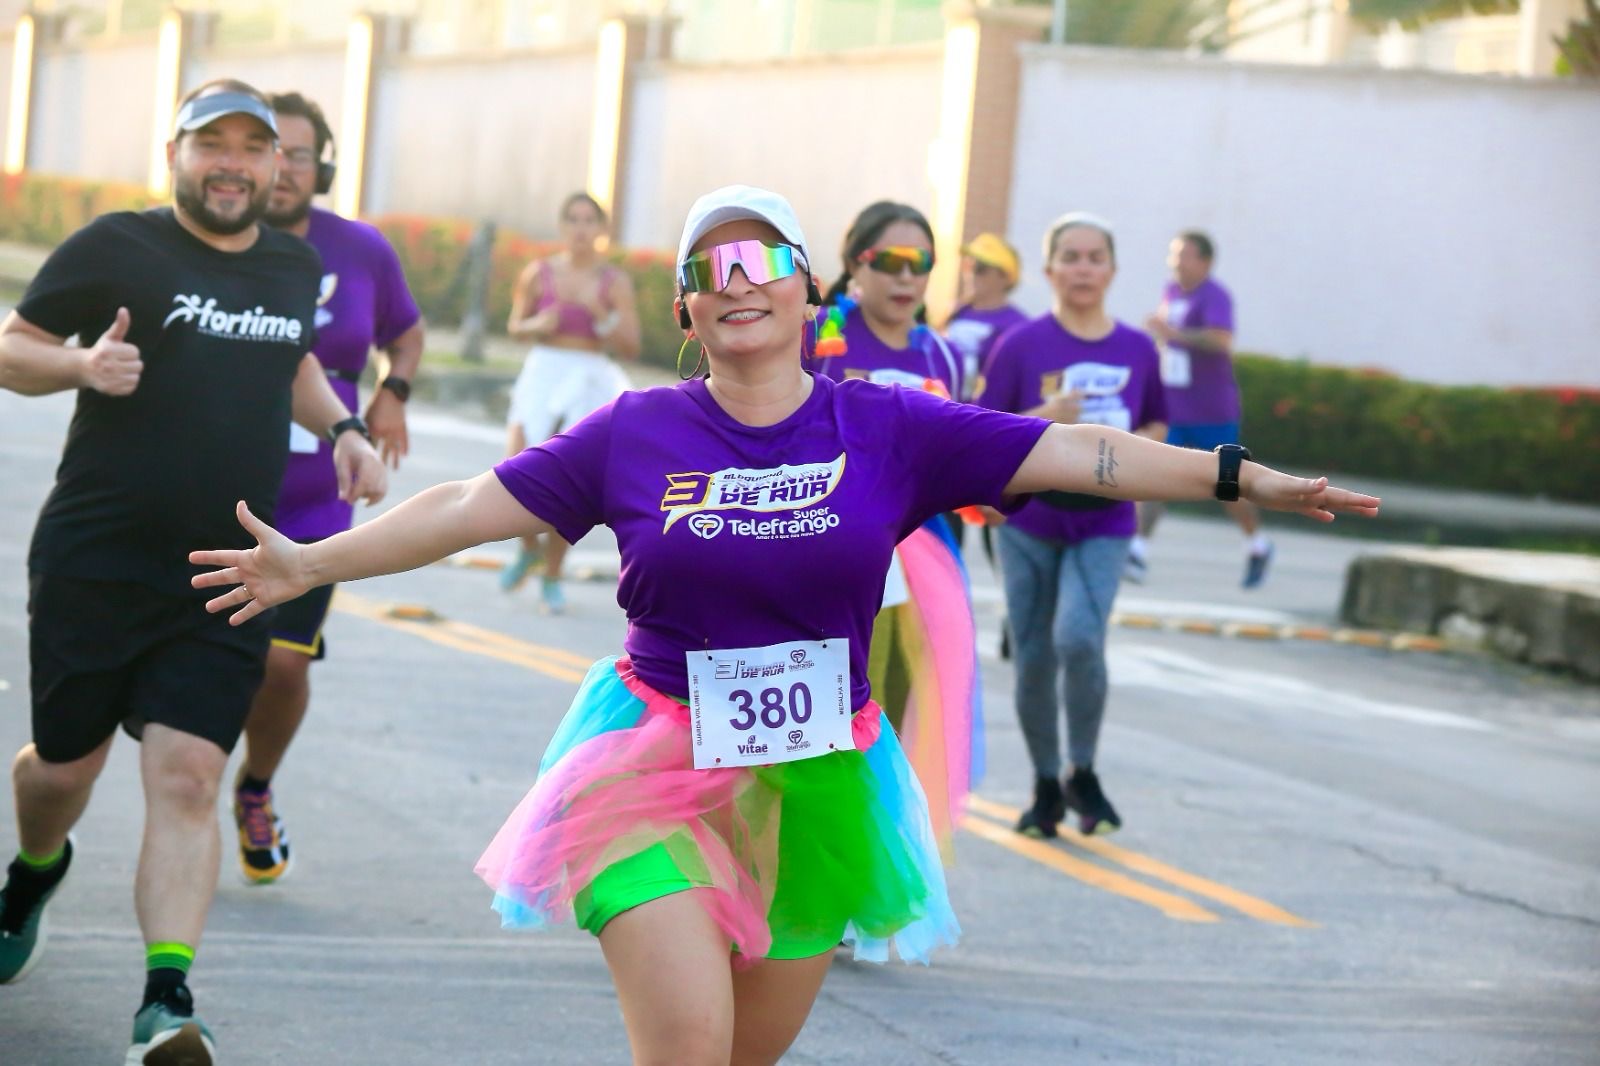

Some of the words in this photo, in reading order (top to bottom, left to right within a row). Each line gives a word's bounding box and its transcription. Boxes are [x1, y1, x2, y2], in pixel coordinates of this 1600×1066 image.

[198, 298, 303, 340] fortime
[719, 490, 760, 505] DE
[769, 480, 828, 503] RUA
[727, 513, 840, 536] Telefrango
[793, 506, 830, 520] Super
[741, 671, 758, 679] DE
[762, 667, 785, 678] RUA
[728, 681, 813, 731] 380
